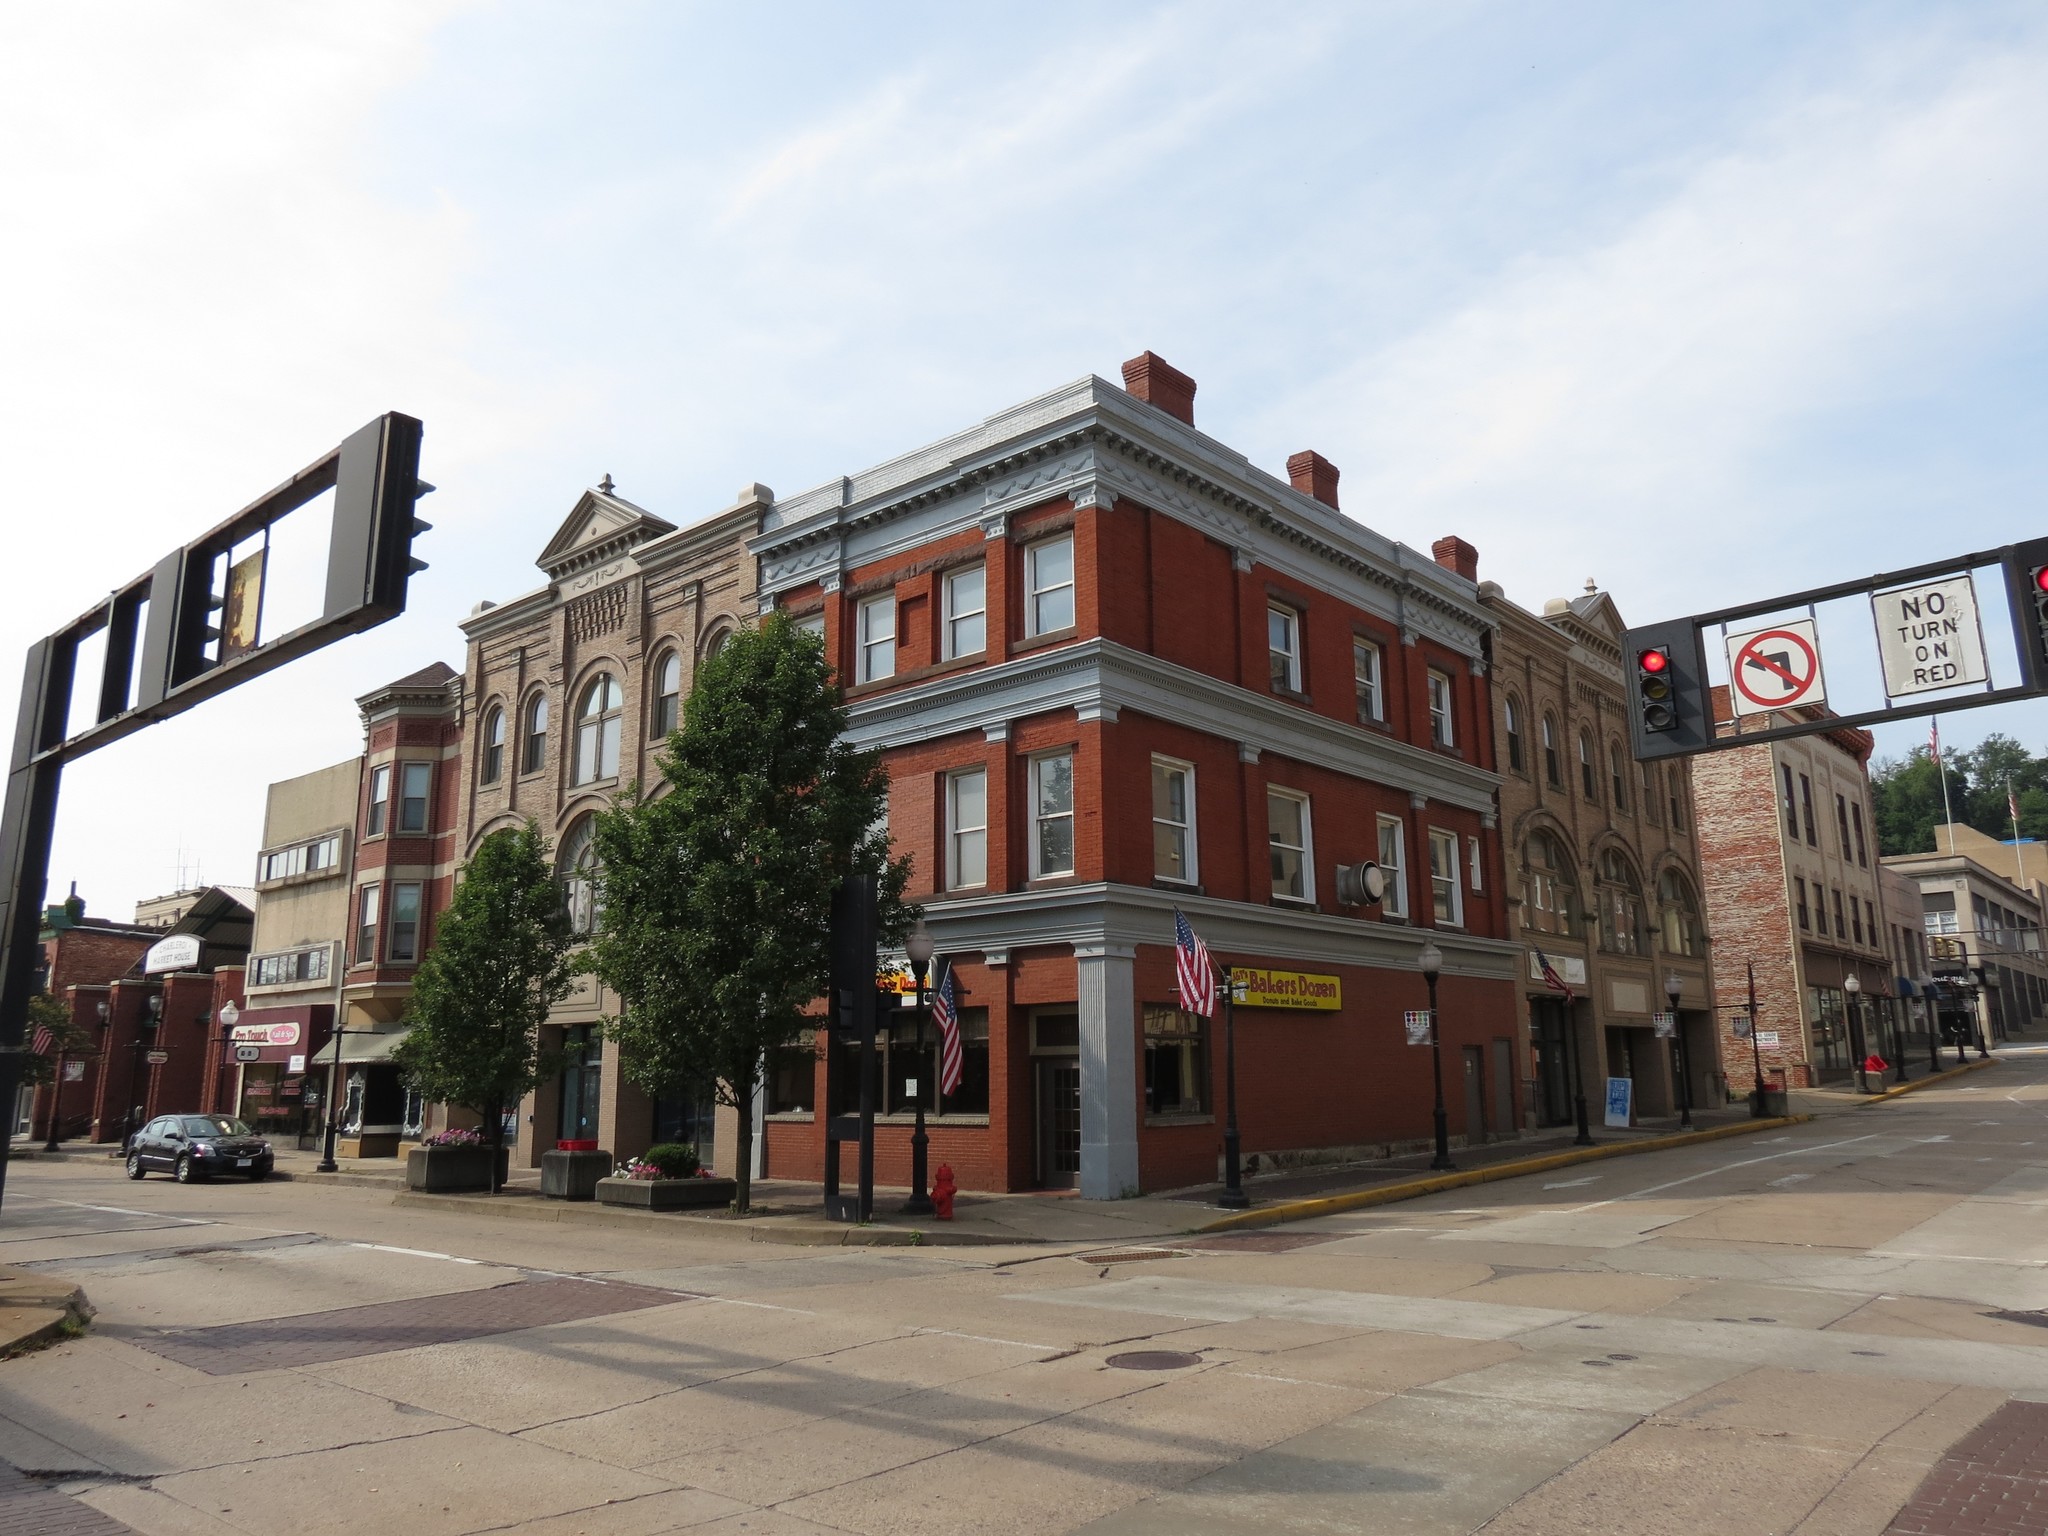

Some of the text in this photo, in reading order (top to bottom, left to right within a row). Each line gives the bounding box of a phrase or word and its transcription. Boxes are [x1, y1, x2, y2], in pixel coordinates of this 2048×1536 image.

[1901, 592, 1945, 621] NO
[1897, 617, 1957, 643] TURN
[1915, 641, 1948, 662] ON
[1913, 663, 1957, 685] RED
[900, 976, 927, 990] Dozn
[1249, 970, 1337, 998] Bakers Dozen
[1262, 996, 1317, 1007] Donuts and Bake Goods
[235, 1028, 268, 1041] Pro Touch
